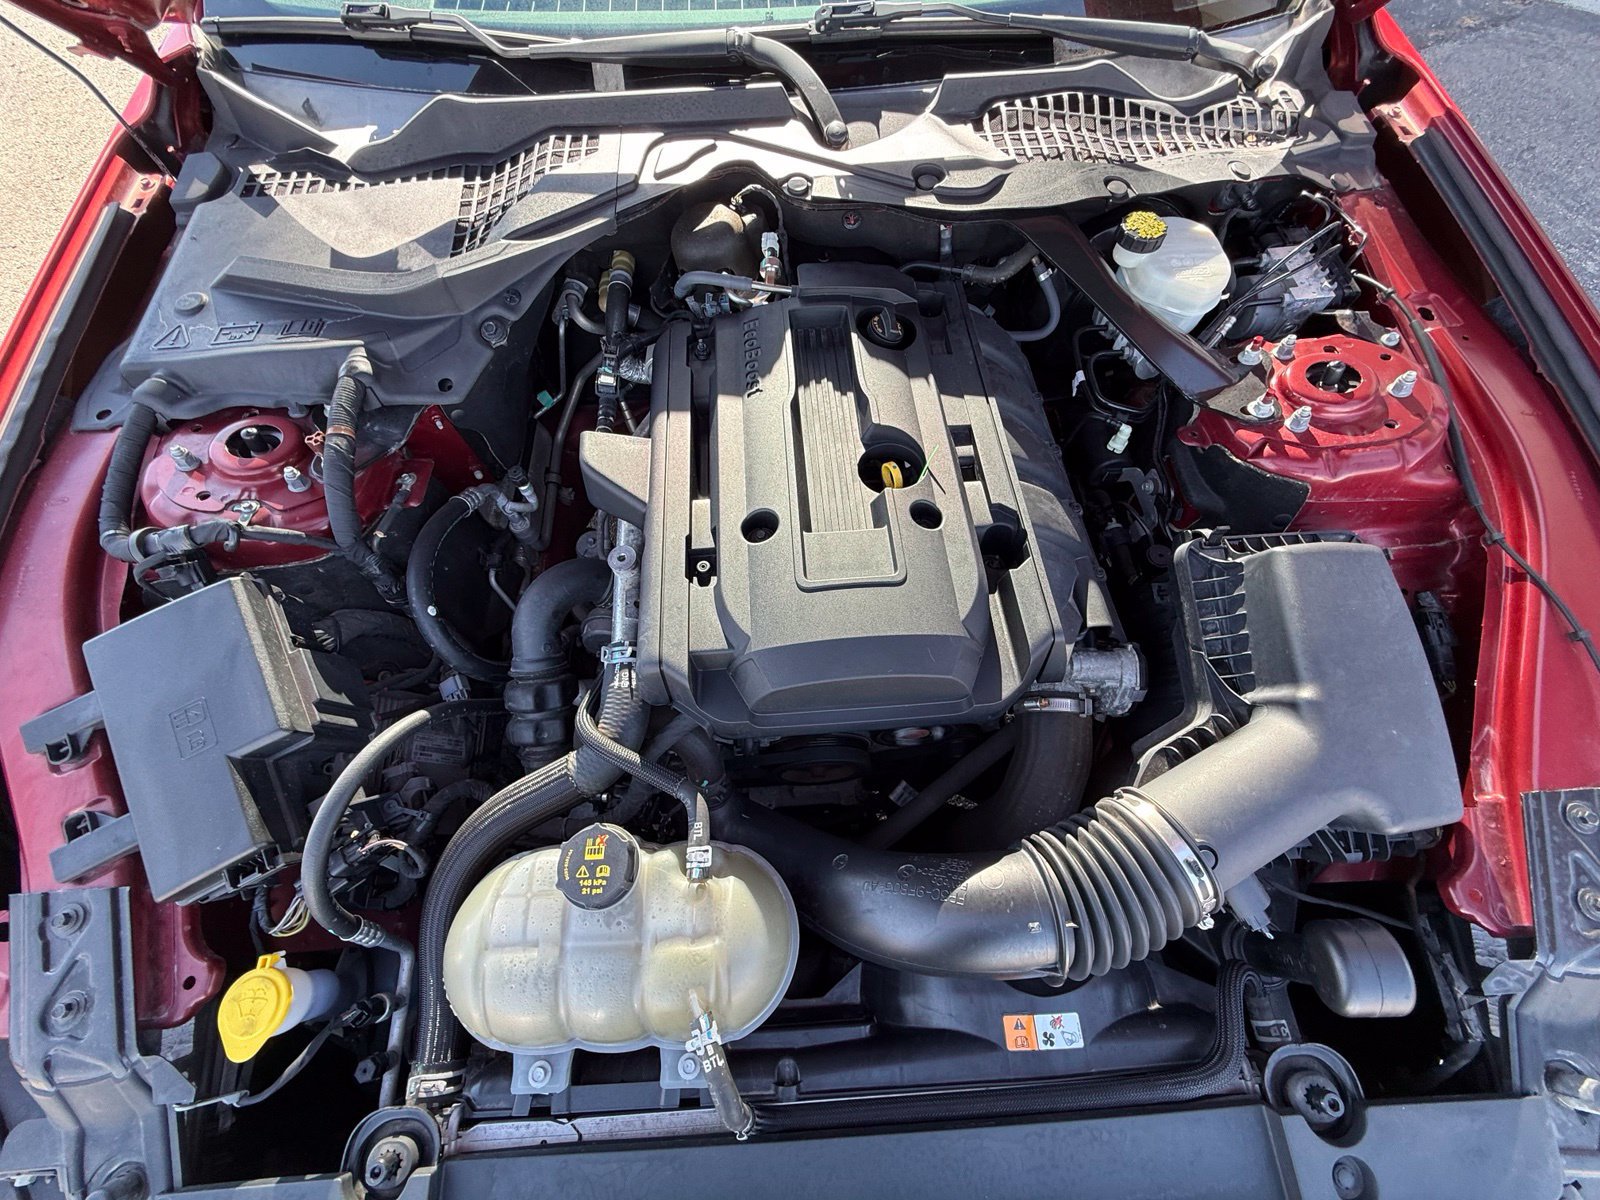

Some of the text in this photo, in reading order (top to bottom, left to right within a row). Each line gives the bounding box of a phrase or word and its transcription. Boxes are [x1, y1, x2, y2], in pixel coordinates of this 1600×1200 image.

[743, 317, 763, 399] EcoBoost
[693, 821, 703, 841] BTL
[579, 878, 607, 887] 145 kPa
[581, 886, 603, 896] 21 psi
[702, 1053, 725, 1073] BTL
